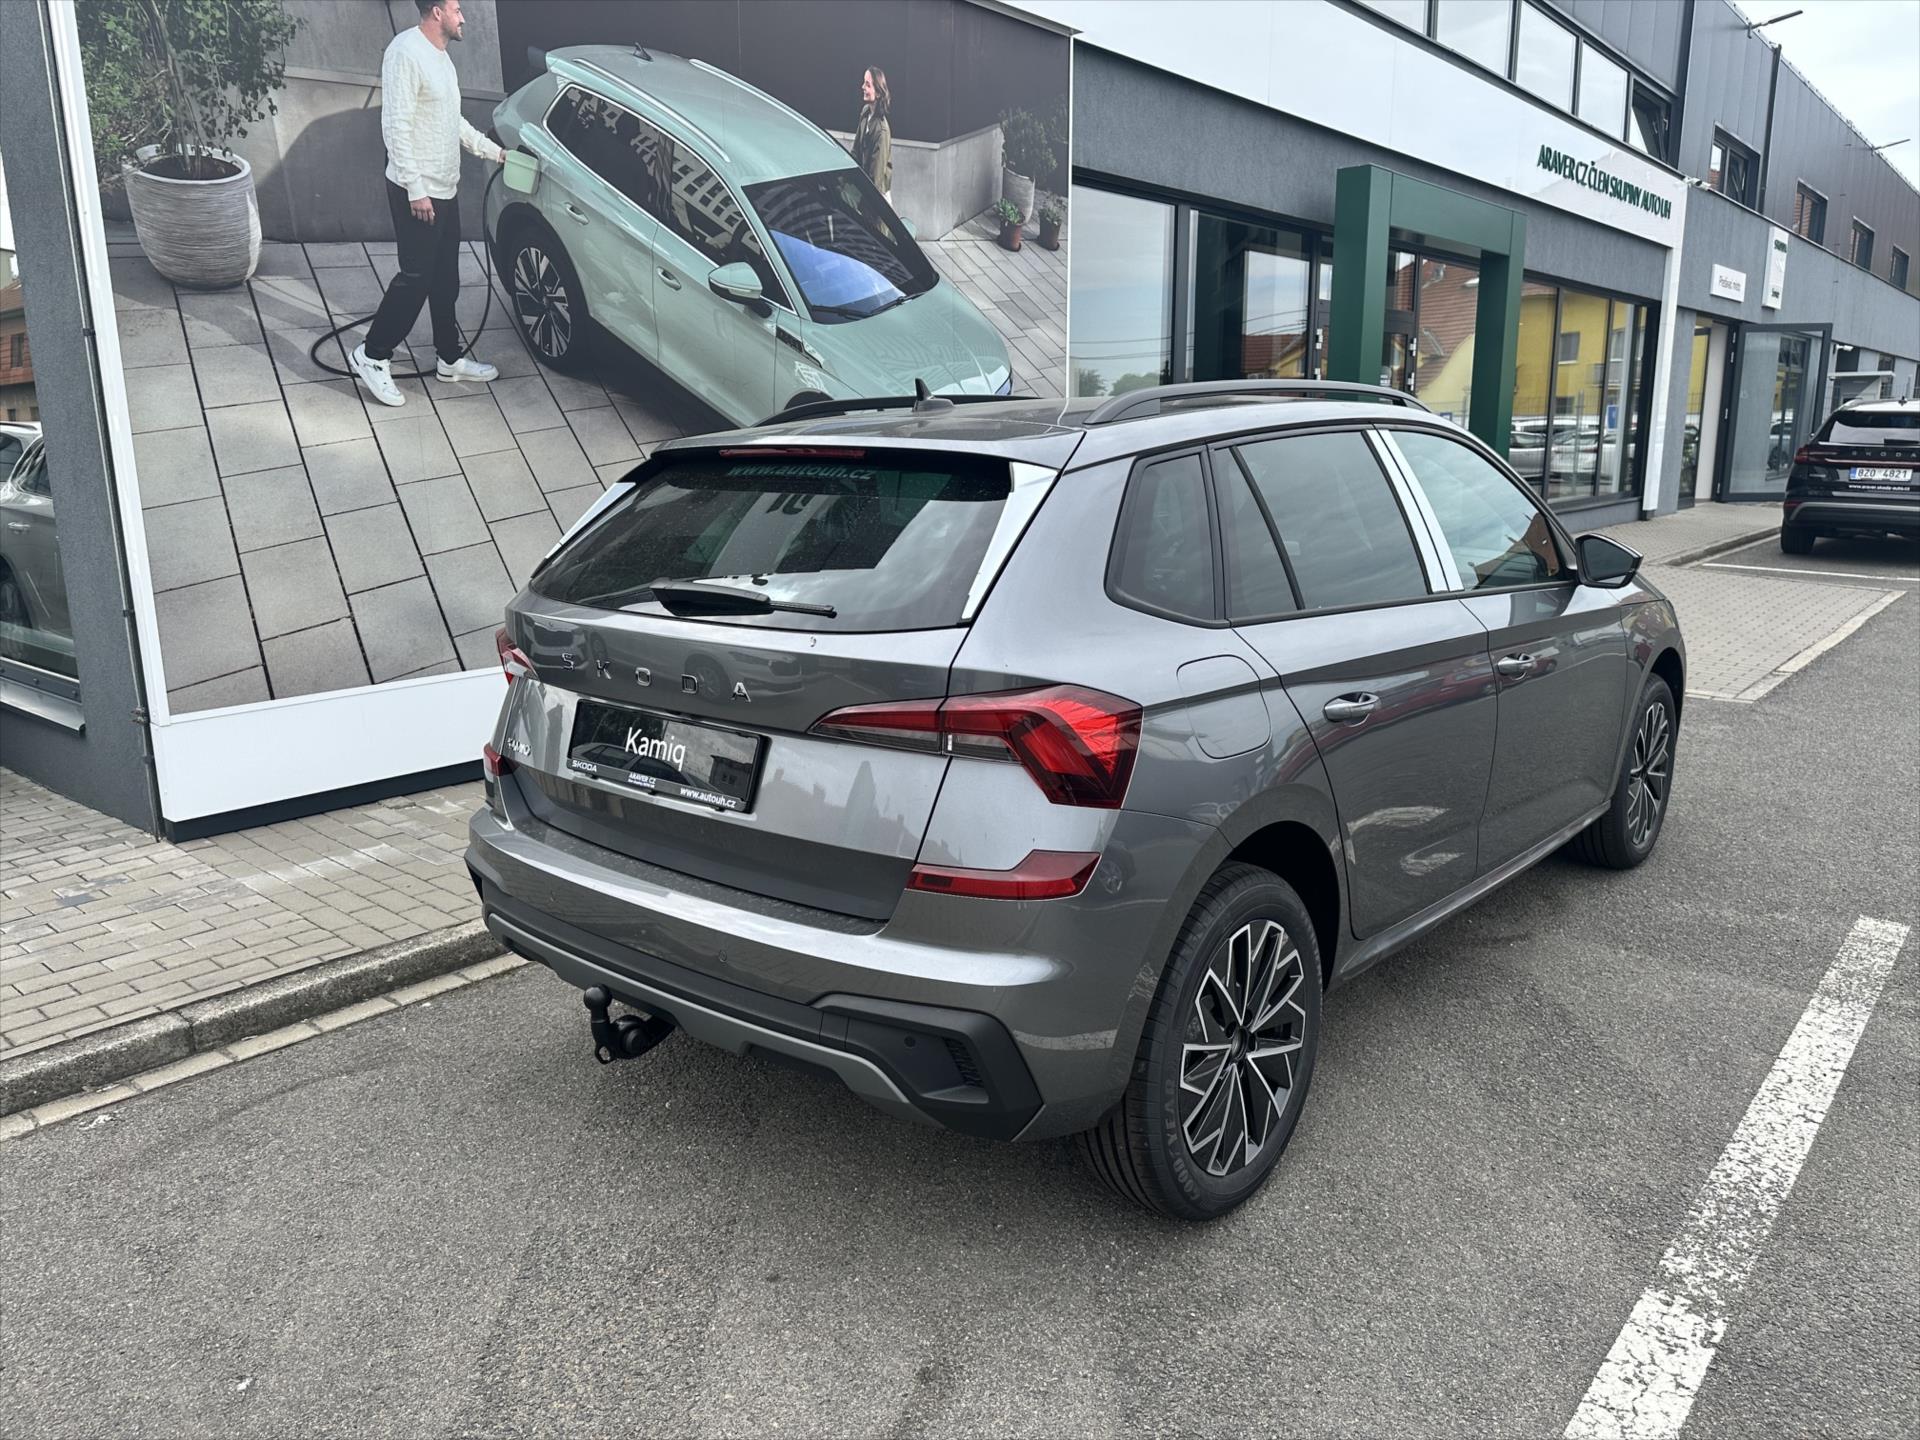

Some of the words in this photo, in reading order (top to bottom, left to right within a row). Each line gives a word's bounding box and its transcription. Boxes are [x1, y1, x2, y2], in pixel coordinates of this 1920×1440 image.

[1537, 144, 1575, 181] ARAVER
[1575, 161, 1589, 187] CZ
[1588, 160, 1610, 194] ČLEN
[1609, 176, 1642, 208] SKUPINY
[727, 464, 876, 480] www.autouh.cz
[1883, 469, 1908, 478] 4821
[625, 727, 687, 772] Kamiq
[680, 787, 737, 809] www.autouh.cz
